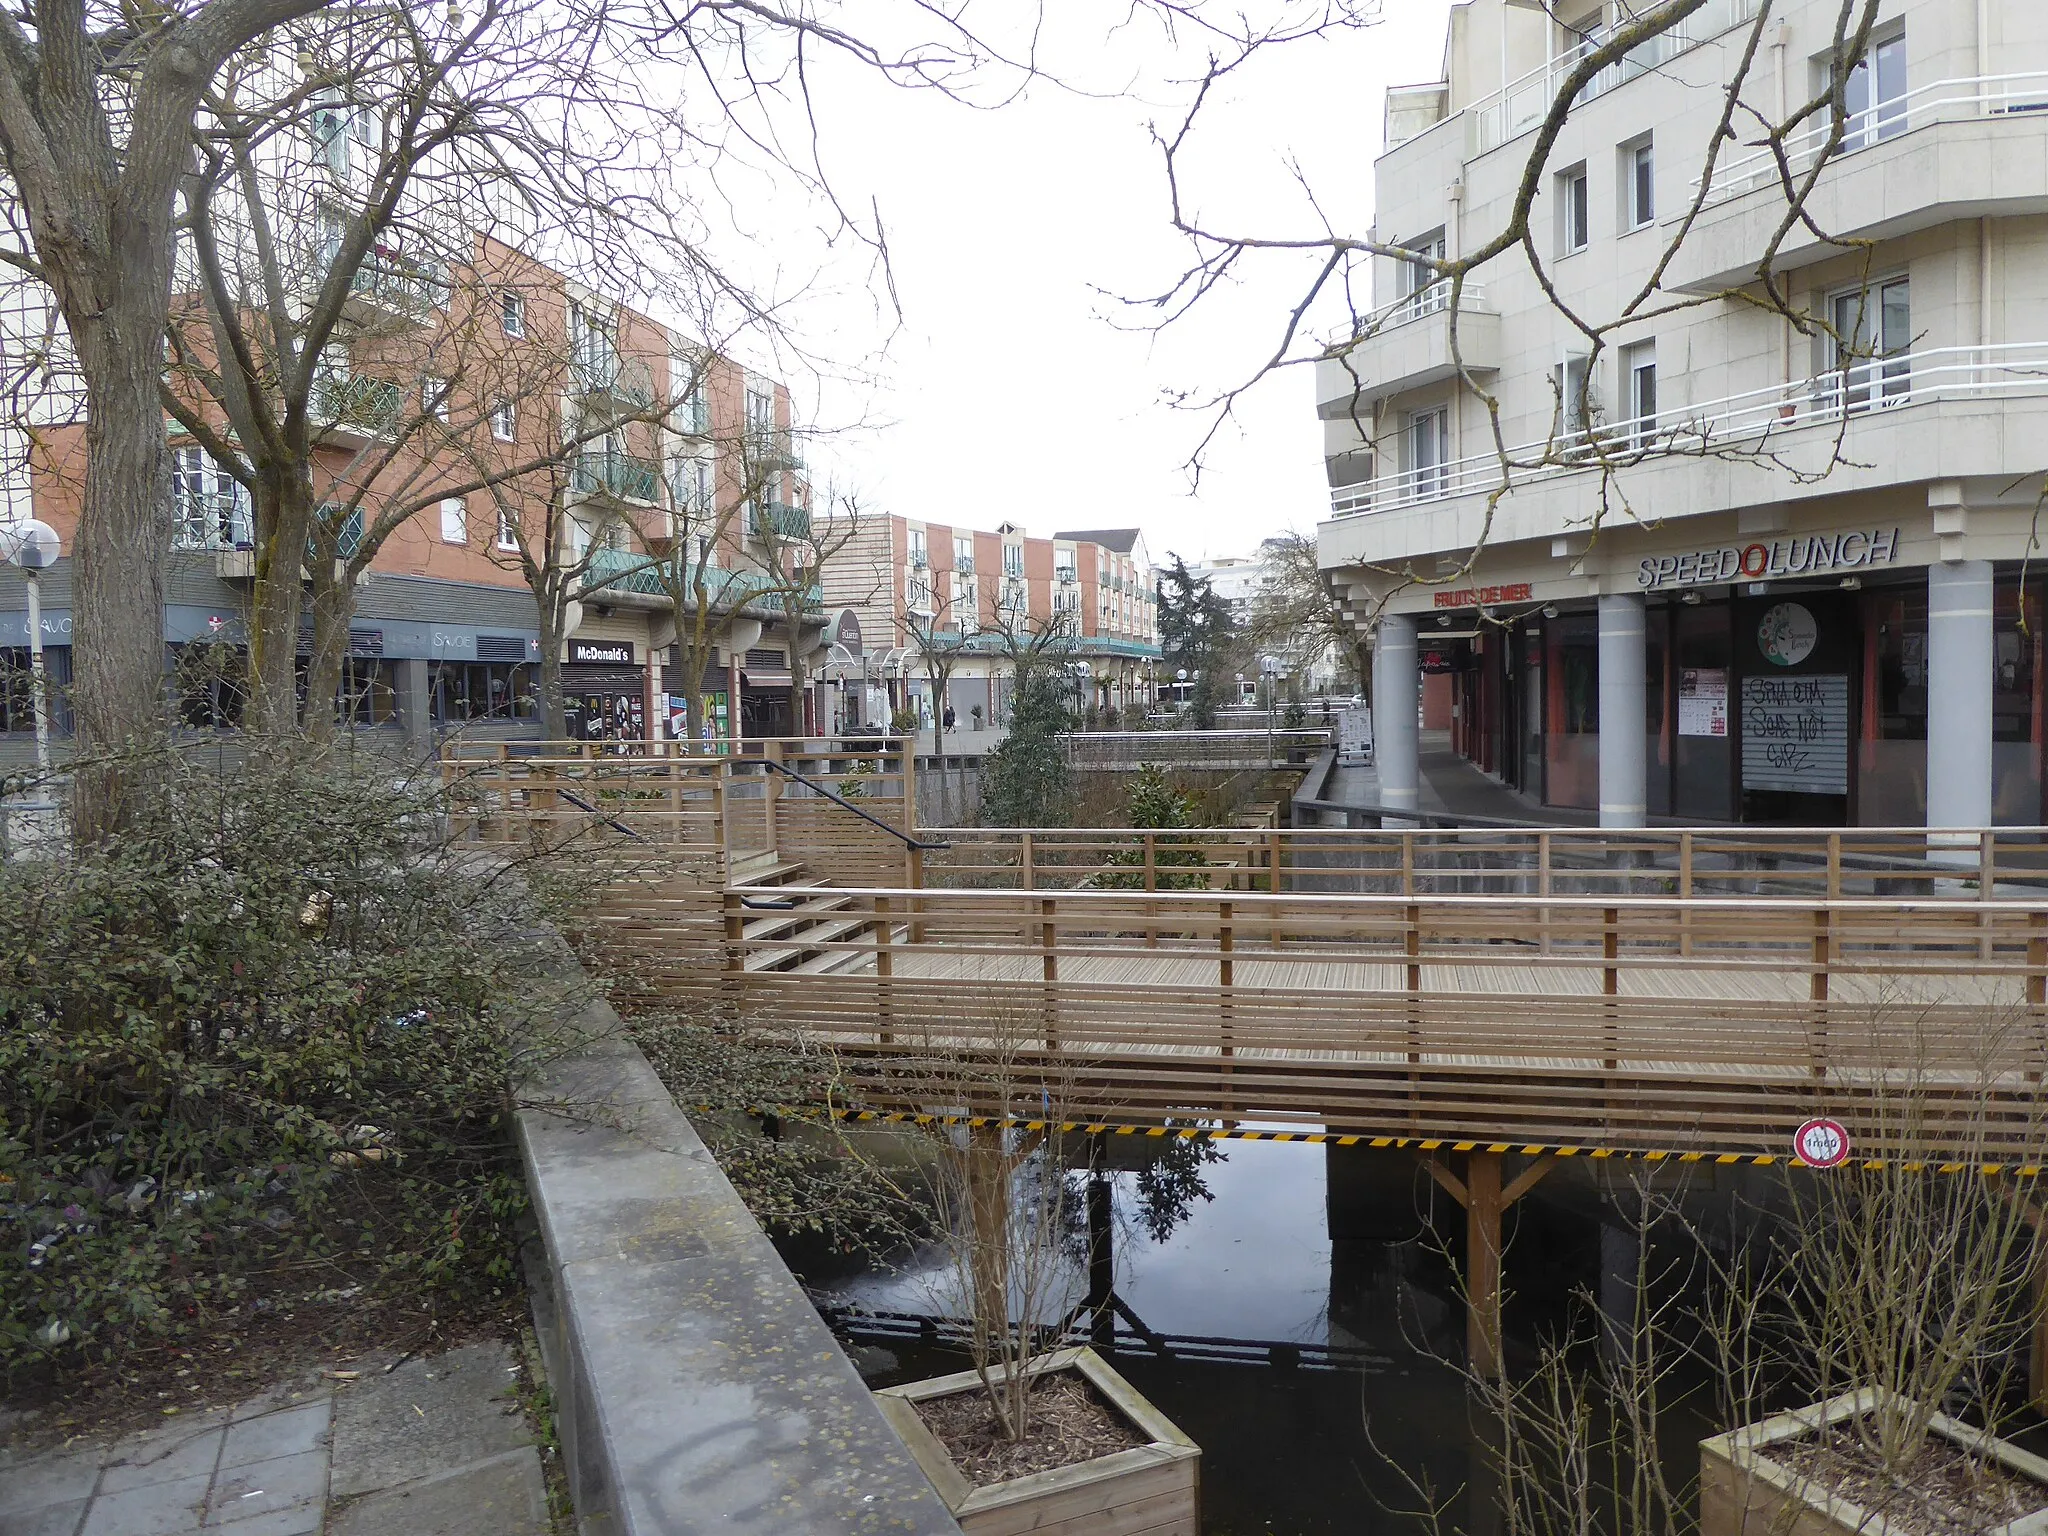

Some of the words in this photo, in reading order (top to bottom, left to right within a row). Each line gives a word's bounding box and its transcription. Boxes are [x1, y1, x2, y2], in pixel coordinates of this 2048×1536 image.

[1434, 587, 1478, 608] FRUITS
[1479, 586, 1499, 604] DE
[24, 617, 72, 634] SAVO
[577, 645, 629, 661] McDonald's
